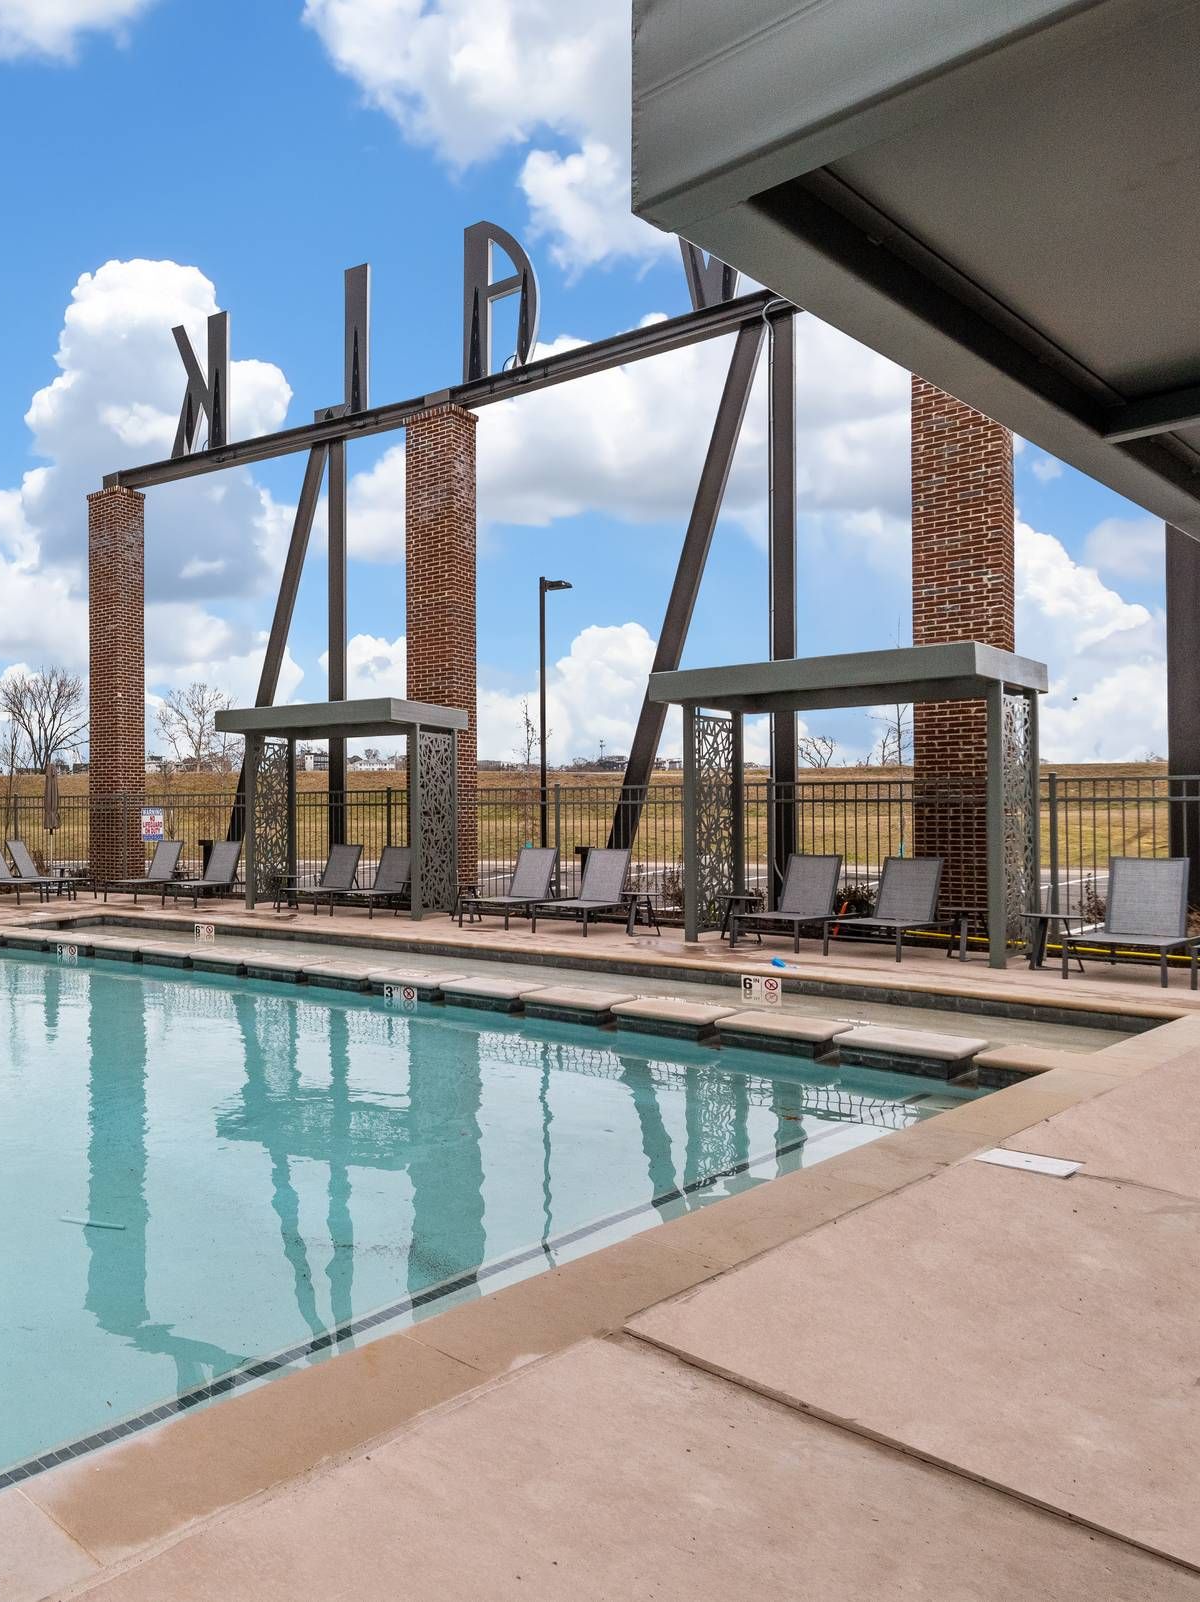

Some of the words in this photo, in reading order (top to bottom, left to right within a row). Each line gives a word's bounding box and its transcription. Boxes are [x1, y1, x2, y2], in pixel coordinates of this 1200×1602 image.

[142, 808, 163, 816] WARNING
[196, 925, 200, 934] 6
[58, 944, 63, 955] 3
[743, 977, 753, 990] 6
[385, 986, 393, 998] 3
